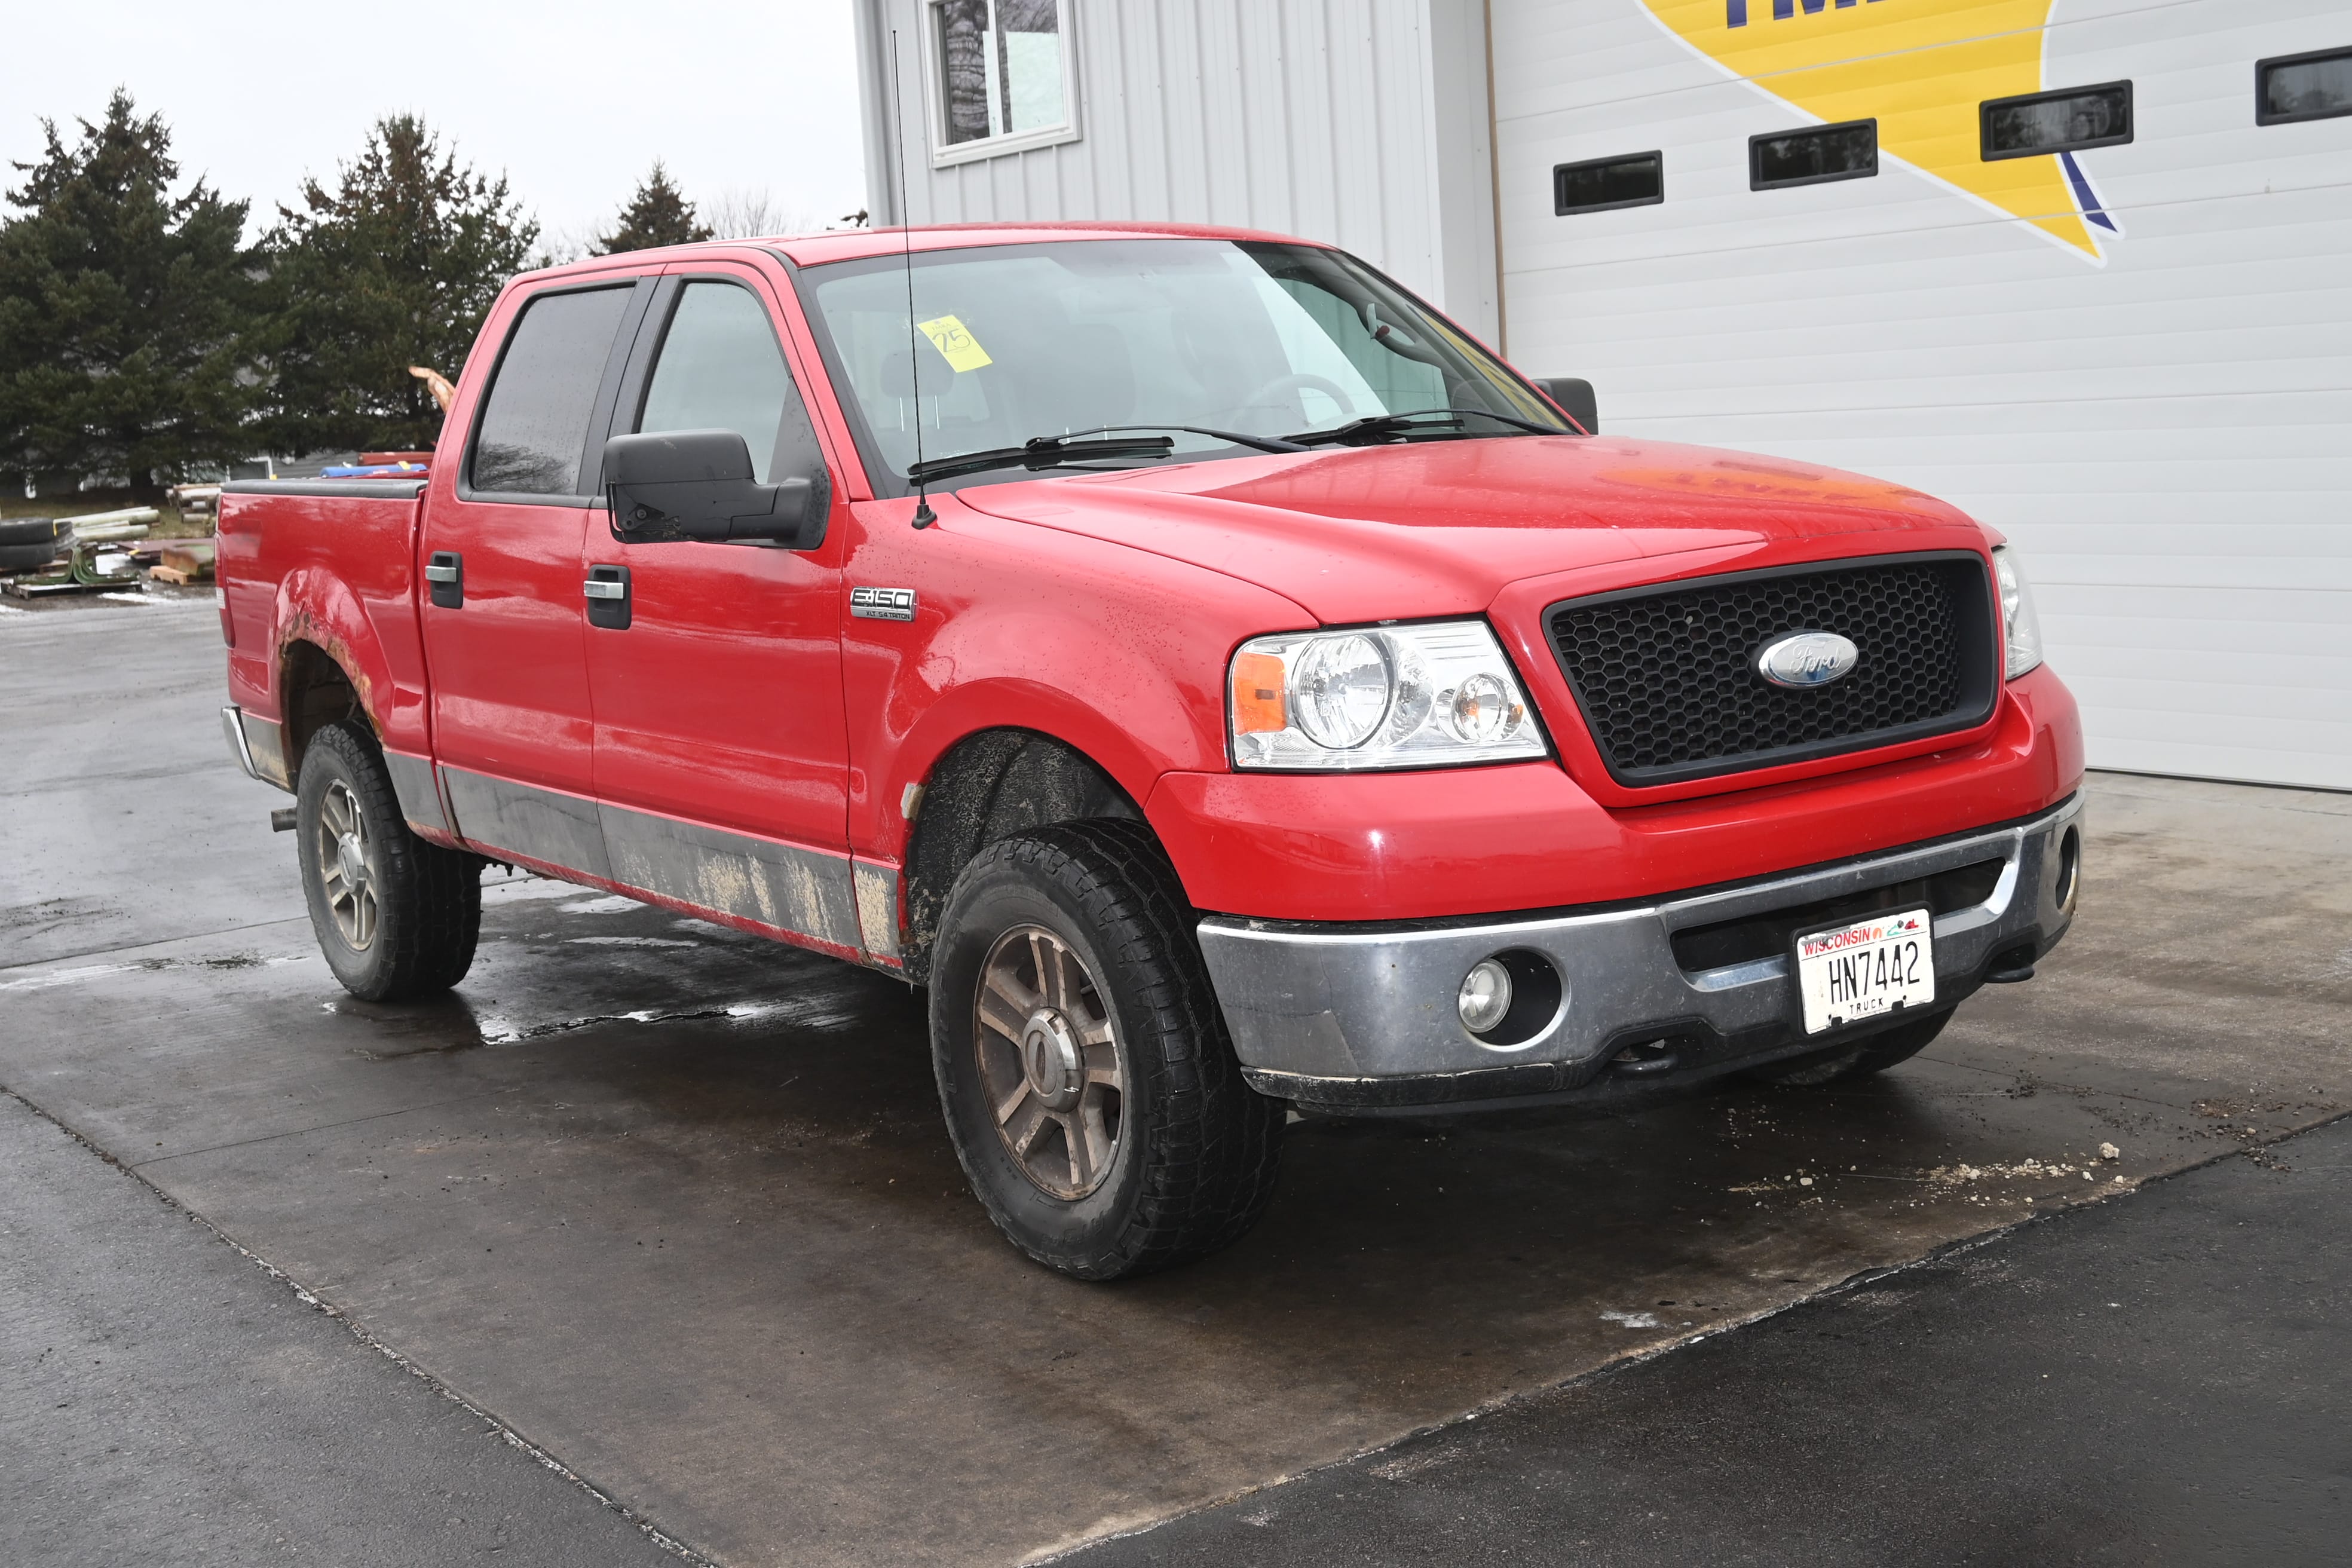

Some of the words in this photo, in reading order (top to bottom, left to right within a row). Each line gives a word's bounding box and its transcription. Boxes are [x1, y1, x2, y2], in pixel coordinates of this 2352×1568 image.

[1789, 643, 1841, 674] Ford
[1805, 927, 1871, 956] WISCONSIN
[1829, 941, 1920, 1004] HN7442
[1849, 997, 1884, 1015] TRUCK
